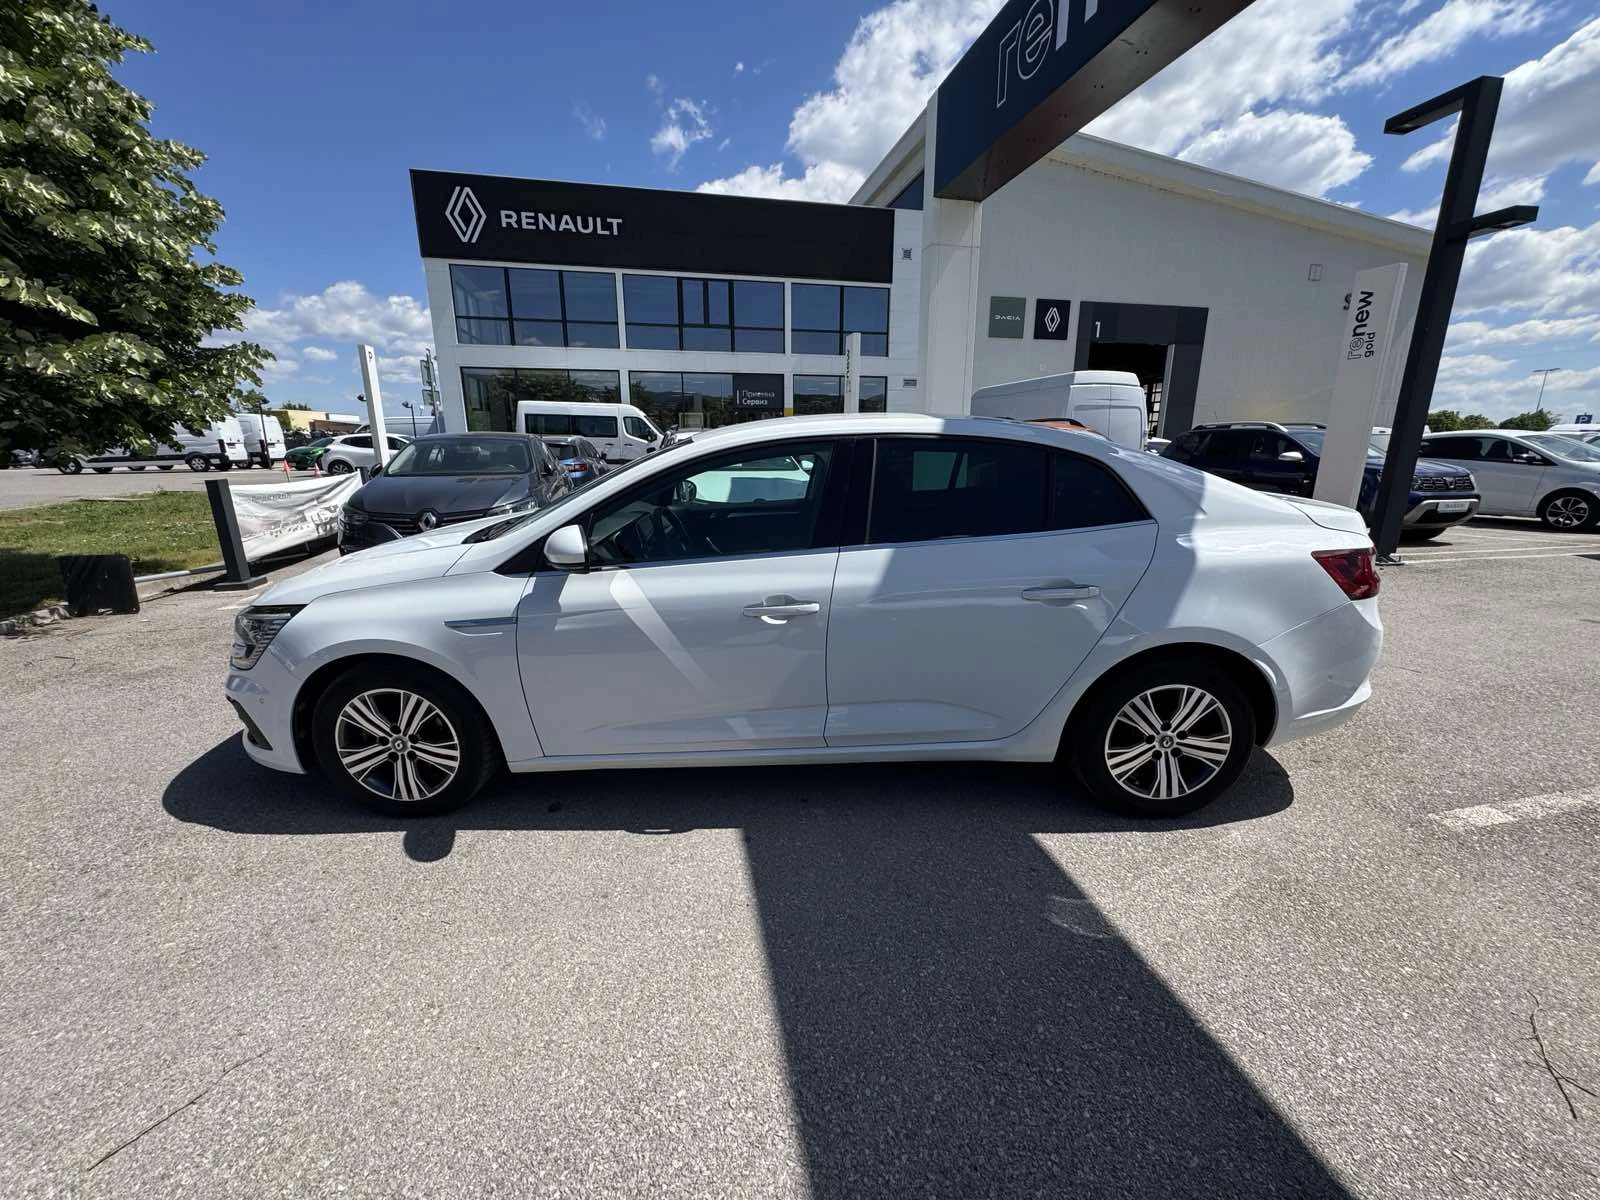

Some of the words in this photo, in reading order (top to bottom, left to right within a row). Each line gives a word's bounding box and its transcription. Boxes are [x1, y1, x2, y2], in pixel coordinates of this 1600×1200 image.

[500, 210, 623, 236] RENAULT
[1095, 321, 1101, 338] 1
[1347, 291, 1374, 360] renew
[1364, 332, 1376, 358] gold
